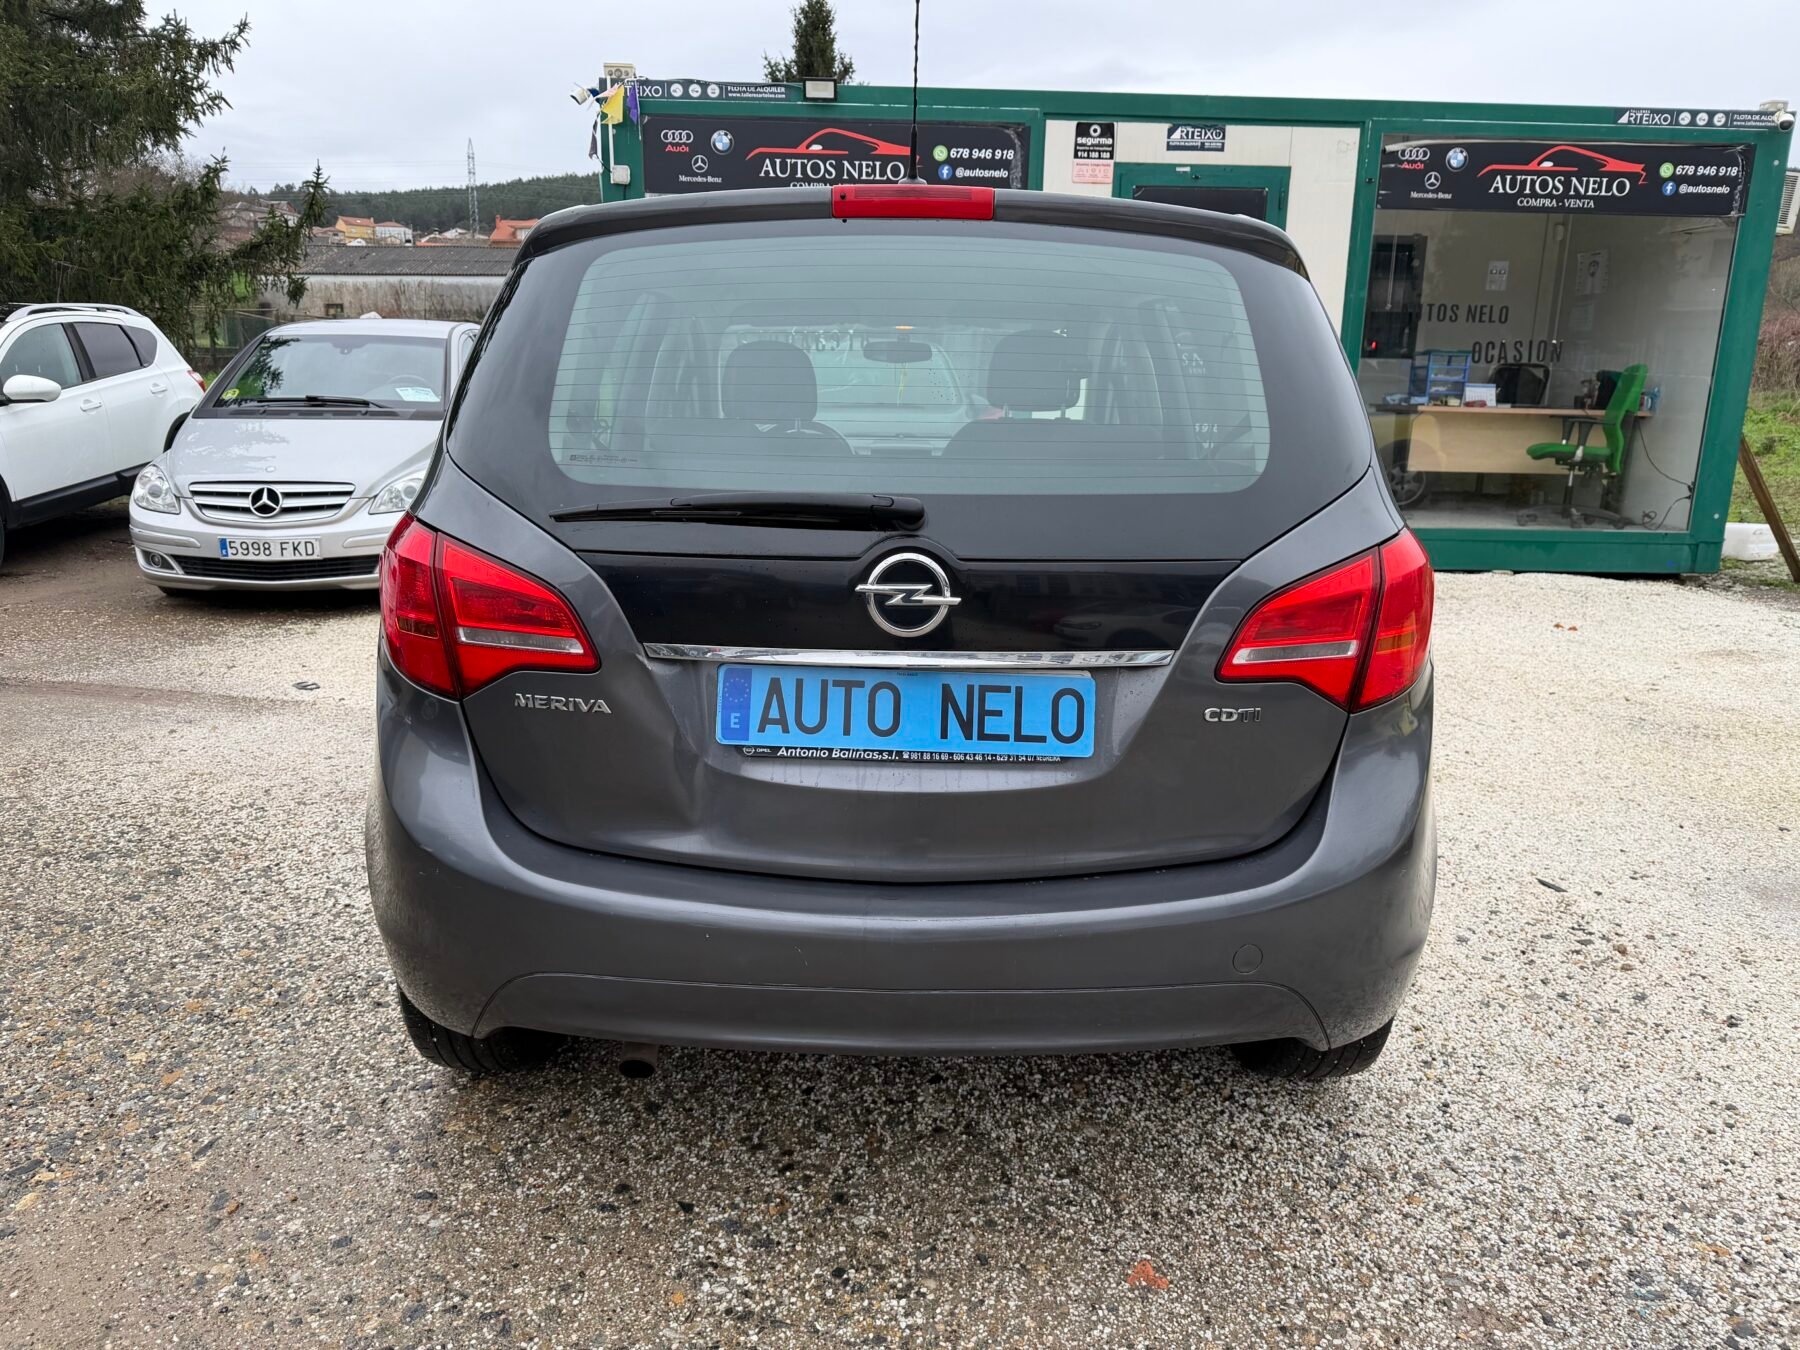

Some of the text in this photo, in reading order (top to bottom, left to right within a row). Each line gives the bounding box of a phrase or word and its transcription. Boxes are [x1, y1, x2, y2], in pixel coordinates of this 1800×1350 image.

[1617, 111, 1671, 125] ARTEIXO
[1170, 126, 1224, 140] ARTEIXO
[665, 144, 689, 152] Audi
[1076, 137, 1113, 146] segurma
[950, 148, 1014, 160] 678 946 918
[759, 158, 905, 181] AUTOS NELO
[955, 166, 1009, 178] @autosnelo
[1402, 161, 1424, 170] Audi
[1675, 165, 1738, 176] 678 946 918
[679, 174, 722, 183] Mercedes-Benz
[1488, 174, 1631, 196] AUTOS NELO
[1678, 183, 1730, 194] @autosnelo
[1517, 197, 1557, 207] COMPRA
[1564, 199, 1595, 208] VENTA
[1465, 304, 1510, 324] NELO
[1471, 340, 1563, 364] OCASION
[228, 540, 272, 557] 5998
[280, 540, 315, 557] FKD
[514, 693, 612, 714] MERIVA
[757, 677, 900, 737] AUTO
[940, 683, 1085, 744] NELO
[1203, 707, 1261, 722] CDTI
[777, 747, 828, 757] Antonio
[910, 752, 921, 760] 981
[922, 752, 931, 760] 88
[953, 753, 965, 761] 606
[966, 753, 974, 761] 43
